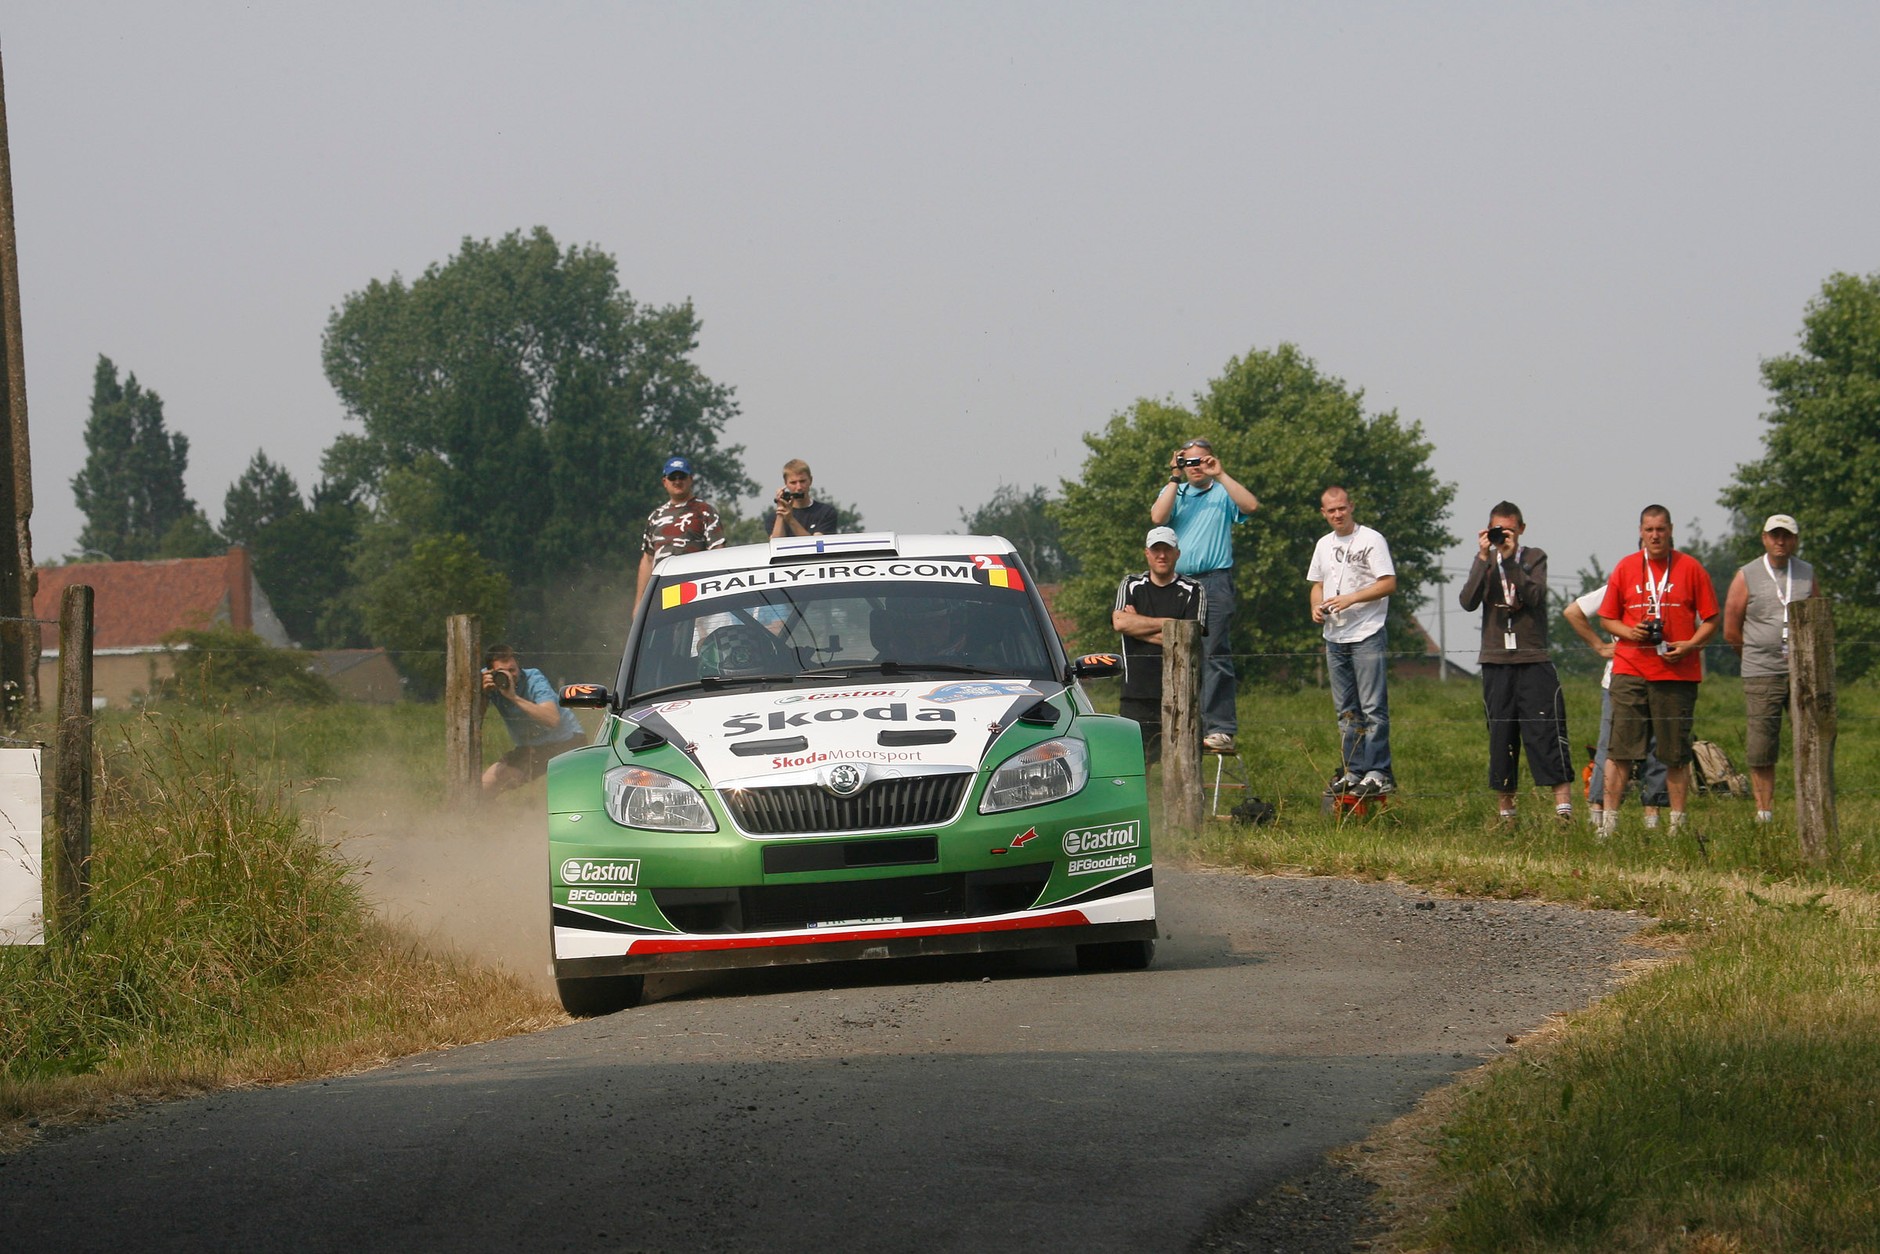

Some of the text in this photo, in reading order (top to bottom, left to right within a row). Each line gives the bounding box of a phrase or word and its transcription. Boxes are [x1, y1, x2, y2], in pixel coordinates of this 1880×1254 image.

[701, 564, 968, 595] RALLY-IRC.COM
[808, 690, 897, 700] Castrol
[722, 703, 956, 738] Škoda
[1081, 825, 1134, 851] Castrol
[581, 862, 634, 881] Castrol
[1068, 852, 1137, 873] BFGoodrich
[568, 889, 637, 902] BFGoodrich
